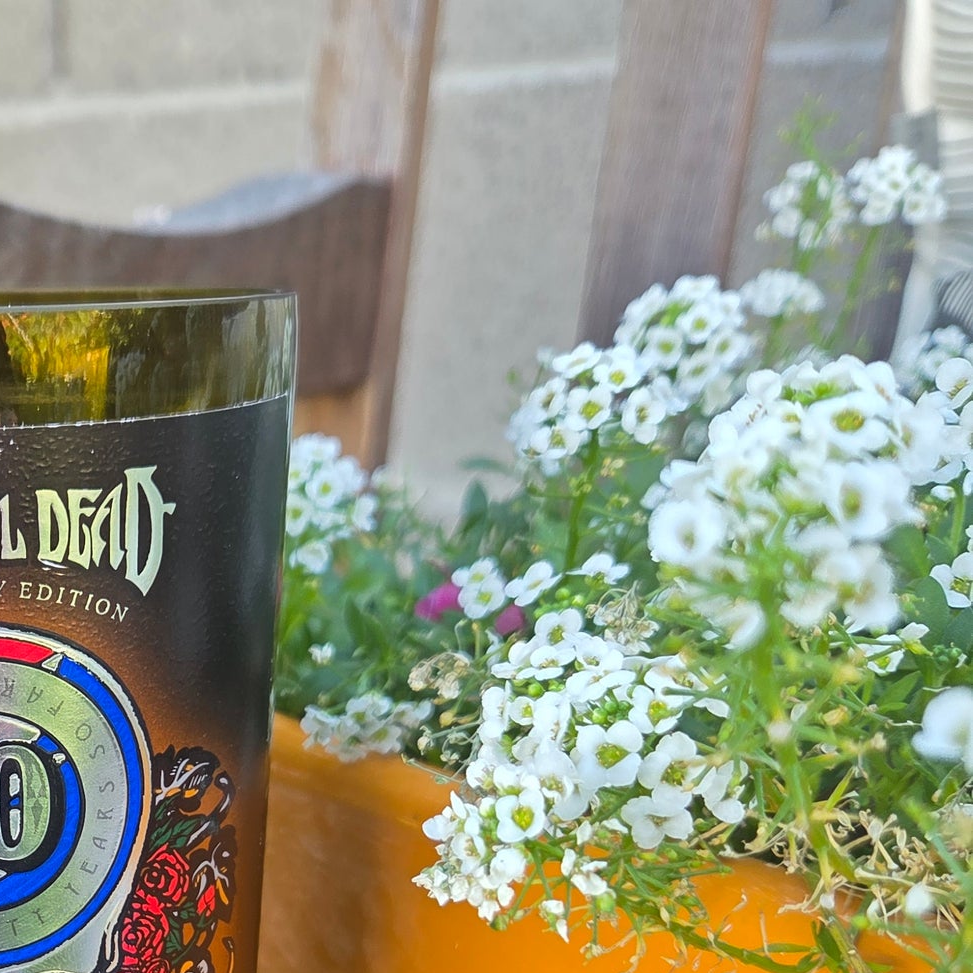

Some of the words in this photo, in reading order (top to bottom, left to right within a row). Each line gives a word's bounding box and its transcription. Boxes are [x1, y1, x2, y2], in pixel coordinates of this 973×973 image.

[34, 465, 176, 597] DEAD
[19, 583, 130, 624] EDITION
[0, 677, 65, 717] FAR
[74, 723, 106, 760] SO
[64, 780, 116, 896] YEARS
